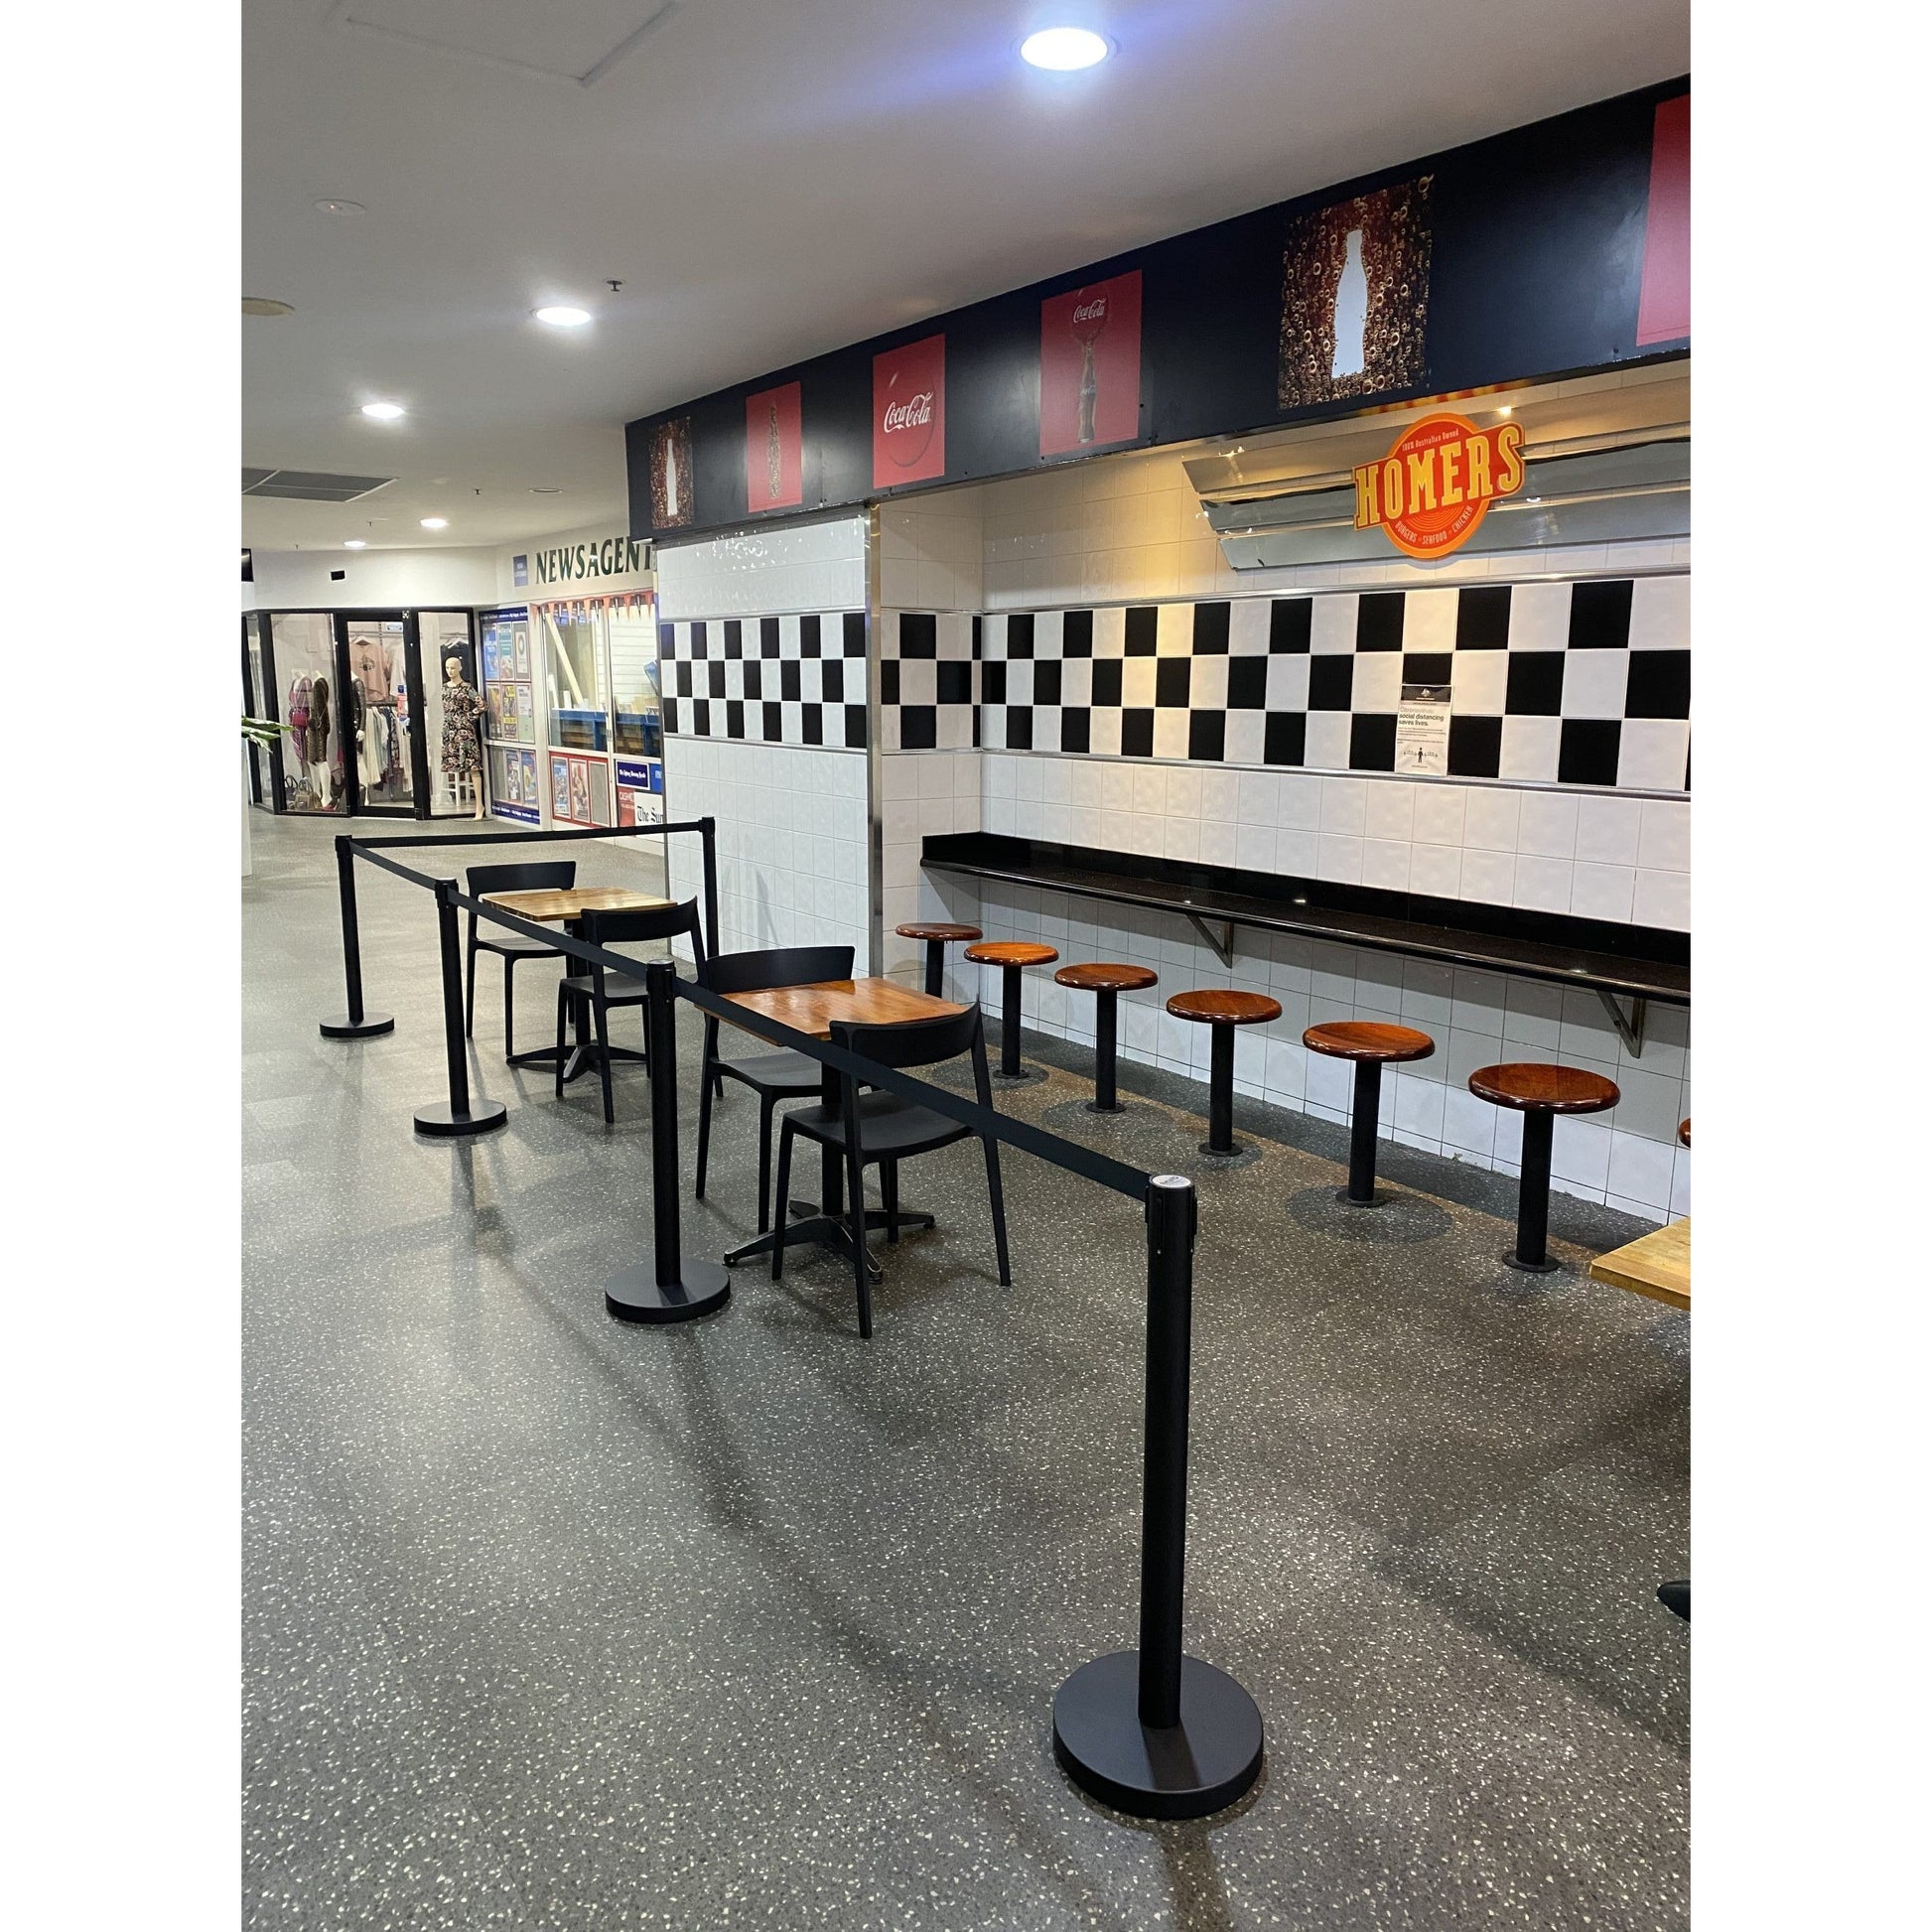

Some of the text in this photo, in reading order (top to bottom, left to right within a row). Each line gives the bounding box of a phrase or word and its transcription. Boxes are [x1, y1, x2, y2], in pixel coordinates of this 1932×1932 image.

[1073, 298, 1107, 324] Coca-Cola
[883, 390, 934, 434] Coca-Cola
[1415, 435, 1442, 448] Australian
[1443, 428, 1459, 440] Owned
[1355, 425, 1522, 527] HOMERS
[1394, 504, 1474, 545] BURGERS SEAFOOD CHICKEN
[1416, 713, 1445, 722] distancing
[637, 805, 649, 822] The
